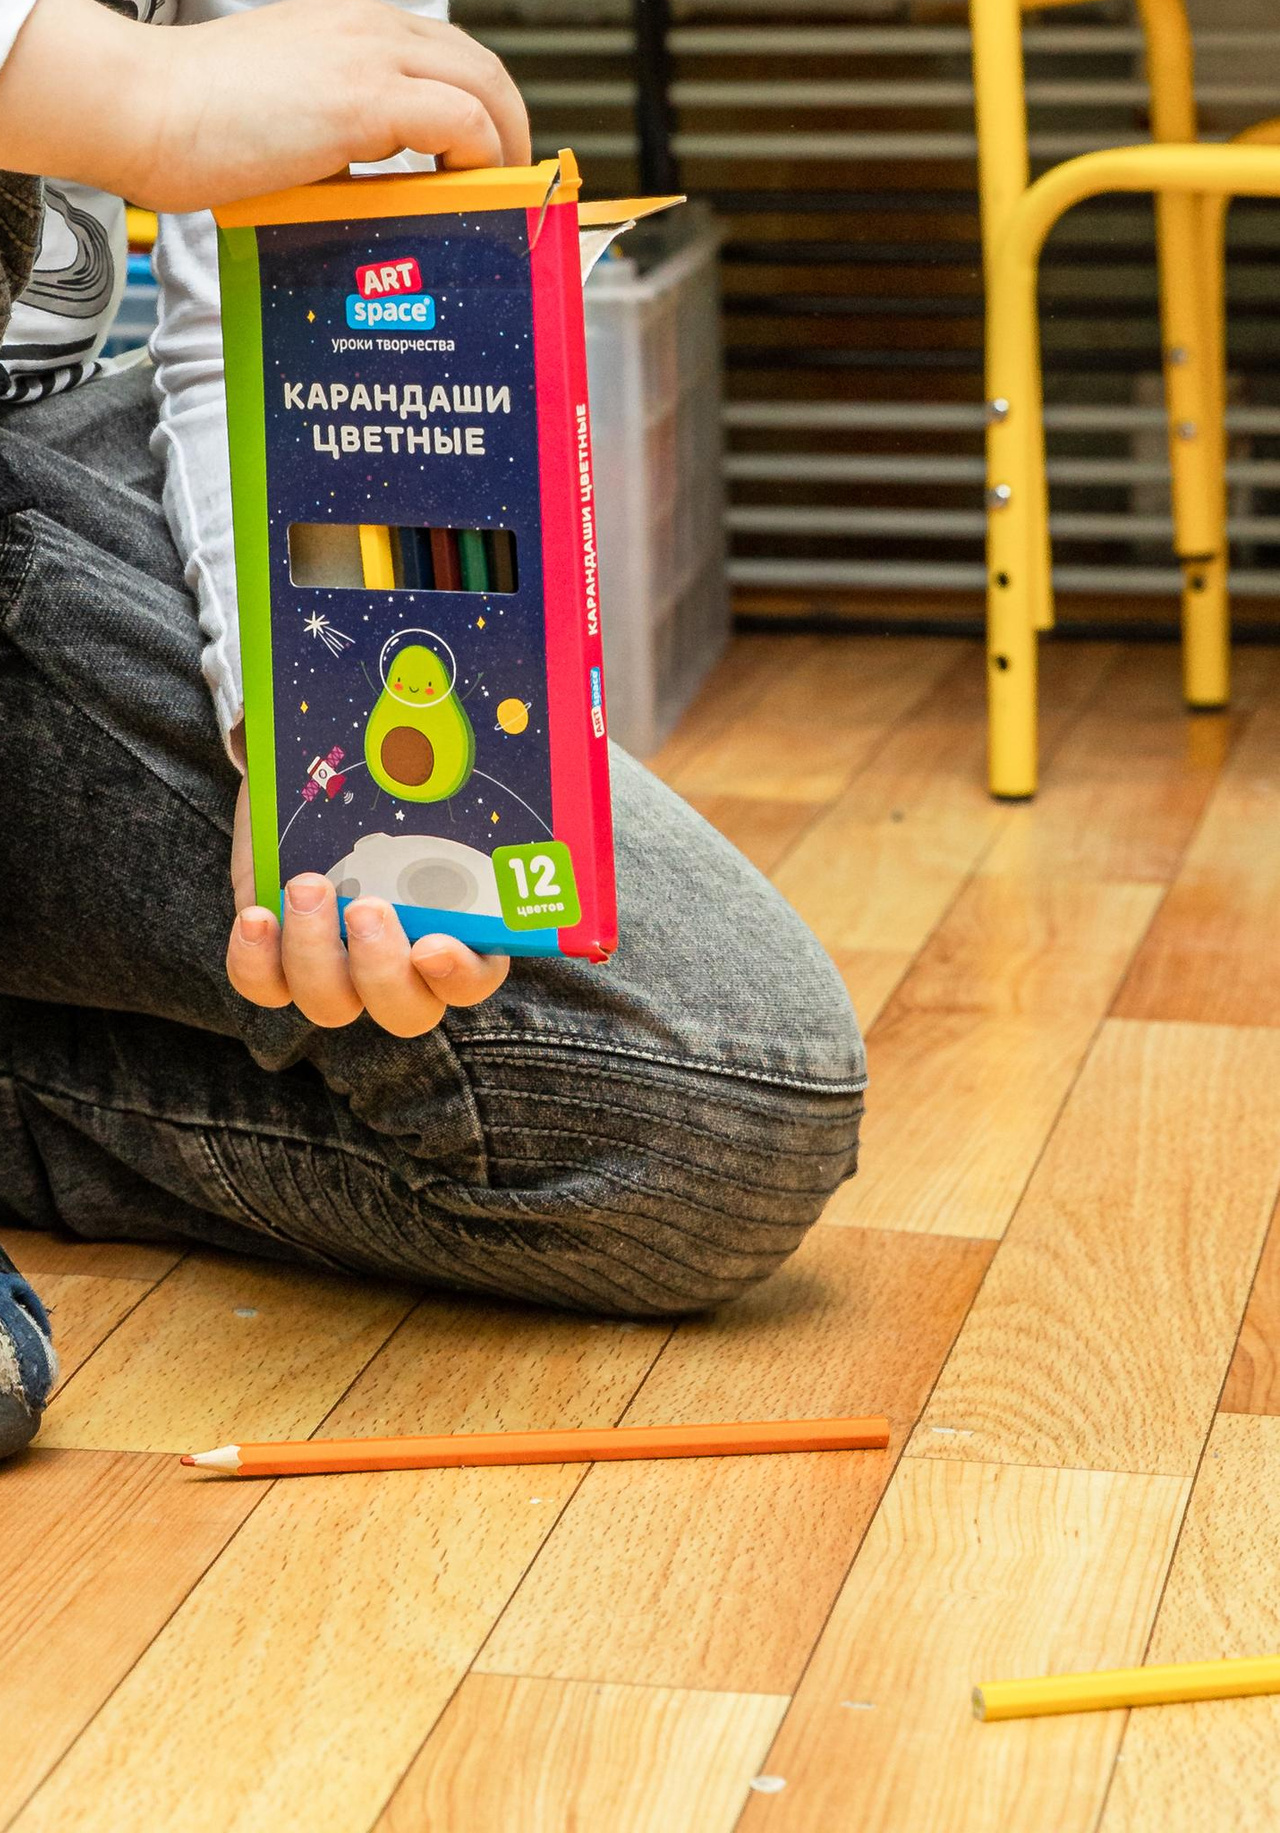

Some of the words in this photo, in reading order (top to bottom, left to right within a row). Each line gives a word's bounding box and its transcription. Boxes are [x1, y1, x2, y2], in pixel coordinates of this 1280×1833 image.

[363, 262, 414, 295] ART
[353, 300, 428, 326] space
[331, 337, 373, 354] уроки
[376, 337, 456, 355] творчества
[283, 381, 511, 421] КАРАНДАШИ
[313, 423, 486, 460] ЦВЕТНЫЕ
[575, 403, 594, 504] ЦВЕТНЫЕ
[580, 505, 599, 637] КАРАНДАШИ
[508, 854, 562, 899] 12
[516, 902, 565, 918] цветов
